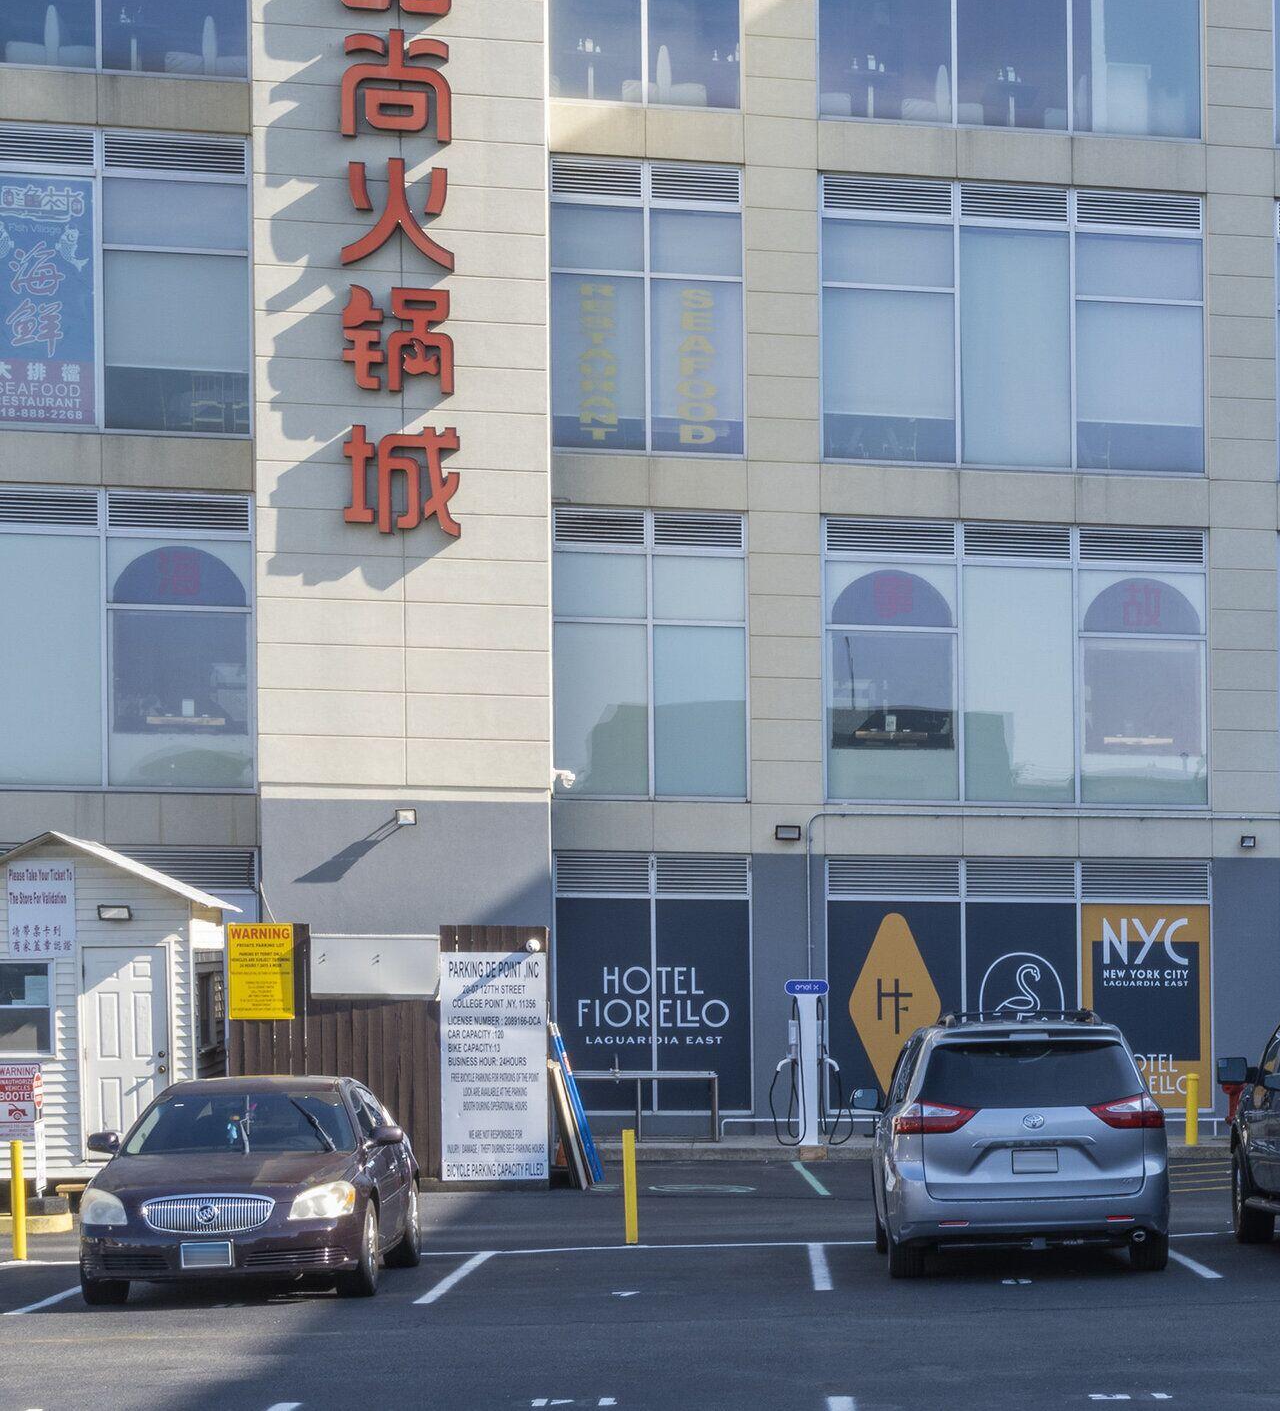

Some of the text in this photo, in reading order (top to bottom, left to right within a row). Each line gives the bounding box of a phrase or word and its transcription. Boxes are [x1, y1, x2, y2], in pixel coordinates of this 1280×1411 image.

[676, 288, 718, 444] SEAFOOD
[0, 395, 82, 409] ESTAURANT
[9, 869, 72, 881] Please Take Your Ticket To
[9, 892, 67, 904] The Store For Validation
[231, 928, 290, 939] WARNING
[1103, 917, 1189, 965] NYC
[448, 961, 483, 978] PARKING
[486, 961, 496, 978] DE
[499, 961, 521, 978] POINT
[1103, 969, 1189, 979] NEW YORK CITY
[603, 966, 704, 994] HOTEL
[480, 985, 500, 994] 127TH
[501, 985, 526, 994] STREET
[452, 999, 536, 1009] COLLEGE POINT 11356
[578, 999, 730, 1027] FIORELLO
[448, 1016, 473, 1025] LICENSE
[474, 1016, 500, 1025] NUMBER
[448, 1030, 460, 1039] CAR
[462, 1030, 491, 1039] CAPACITY
[585, 1036, 723, 1044] LAGUARDIA EAST
[448, 1043, 461, 1053] BIKE
[448, 1057, 478, 1066] BUSINESS
[1133, 1053, 1178, 1073] OTEL
[447, 1163, 544, 1177] BICYCLE PARKING CAPACITY FILLED
